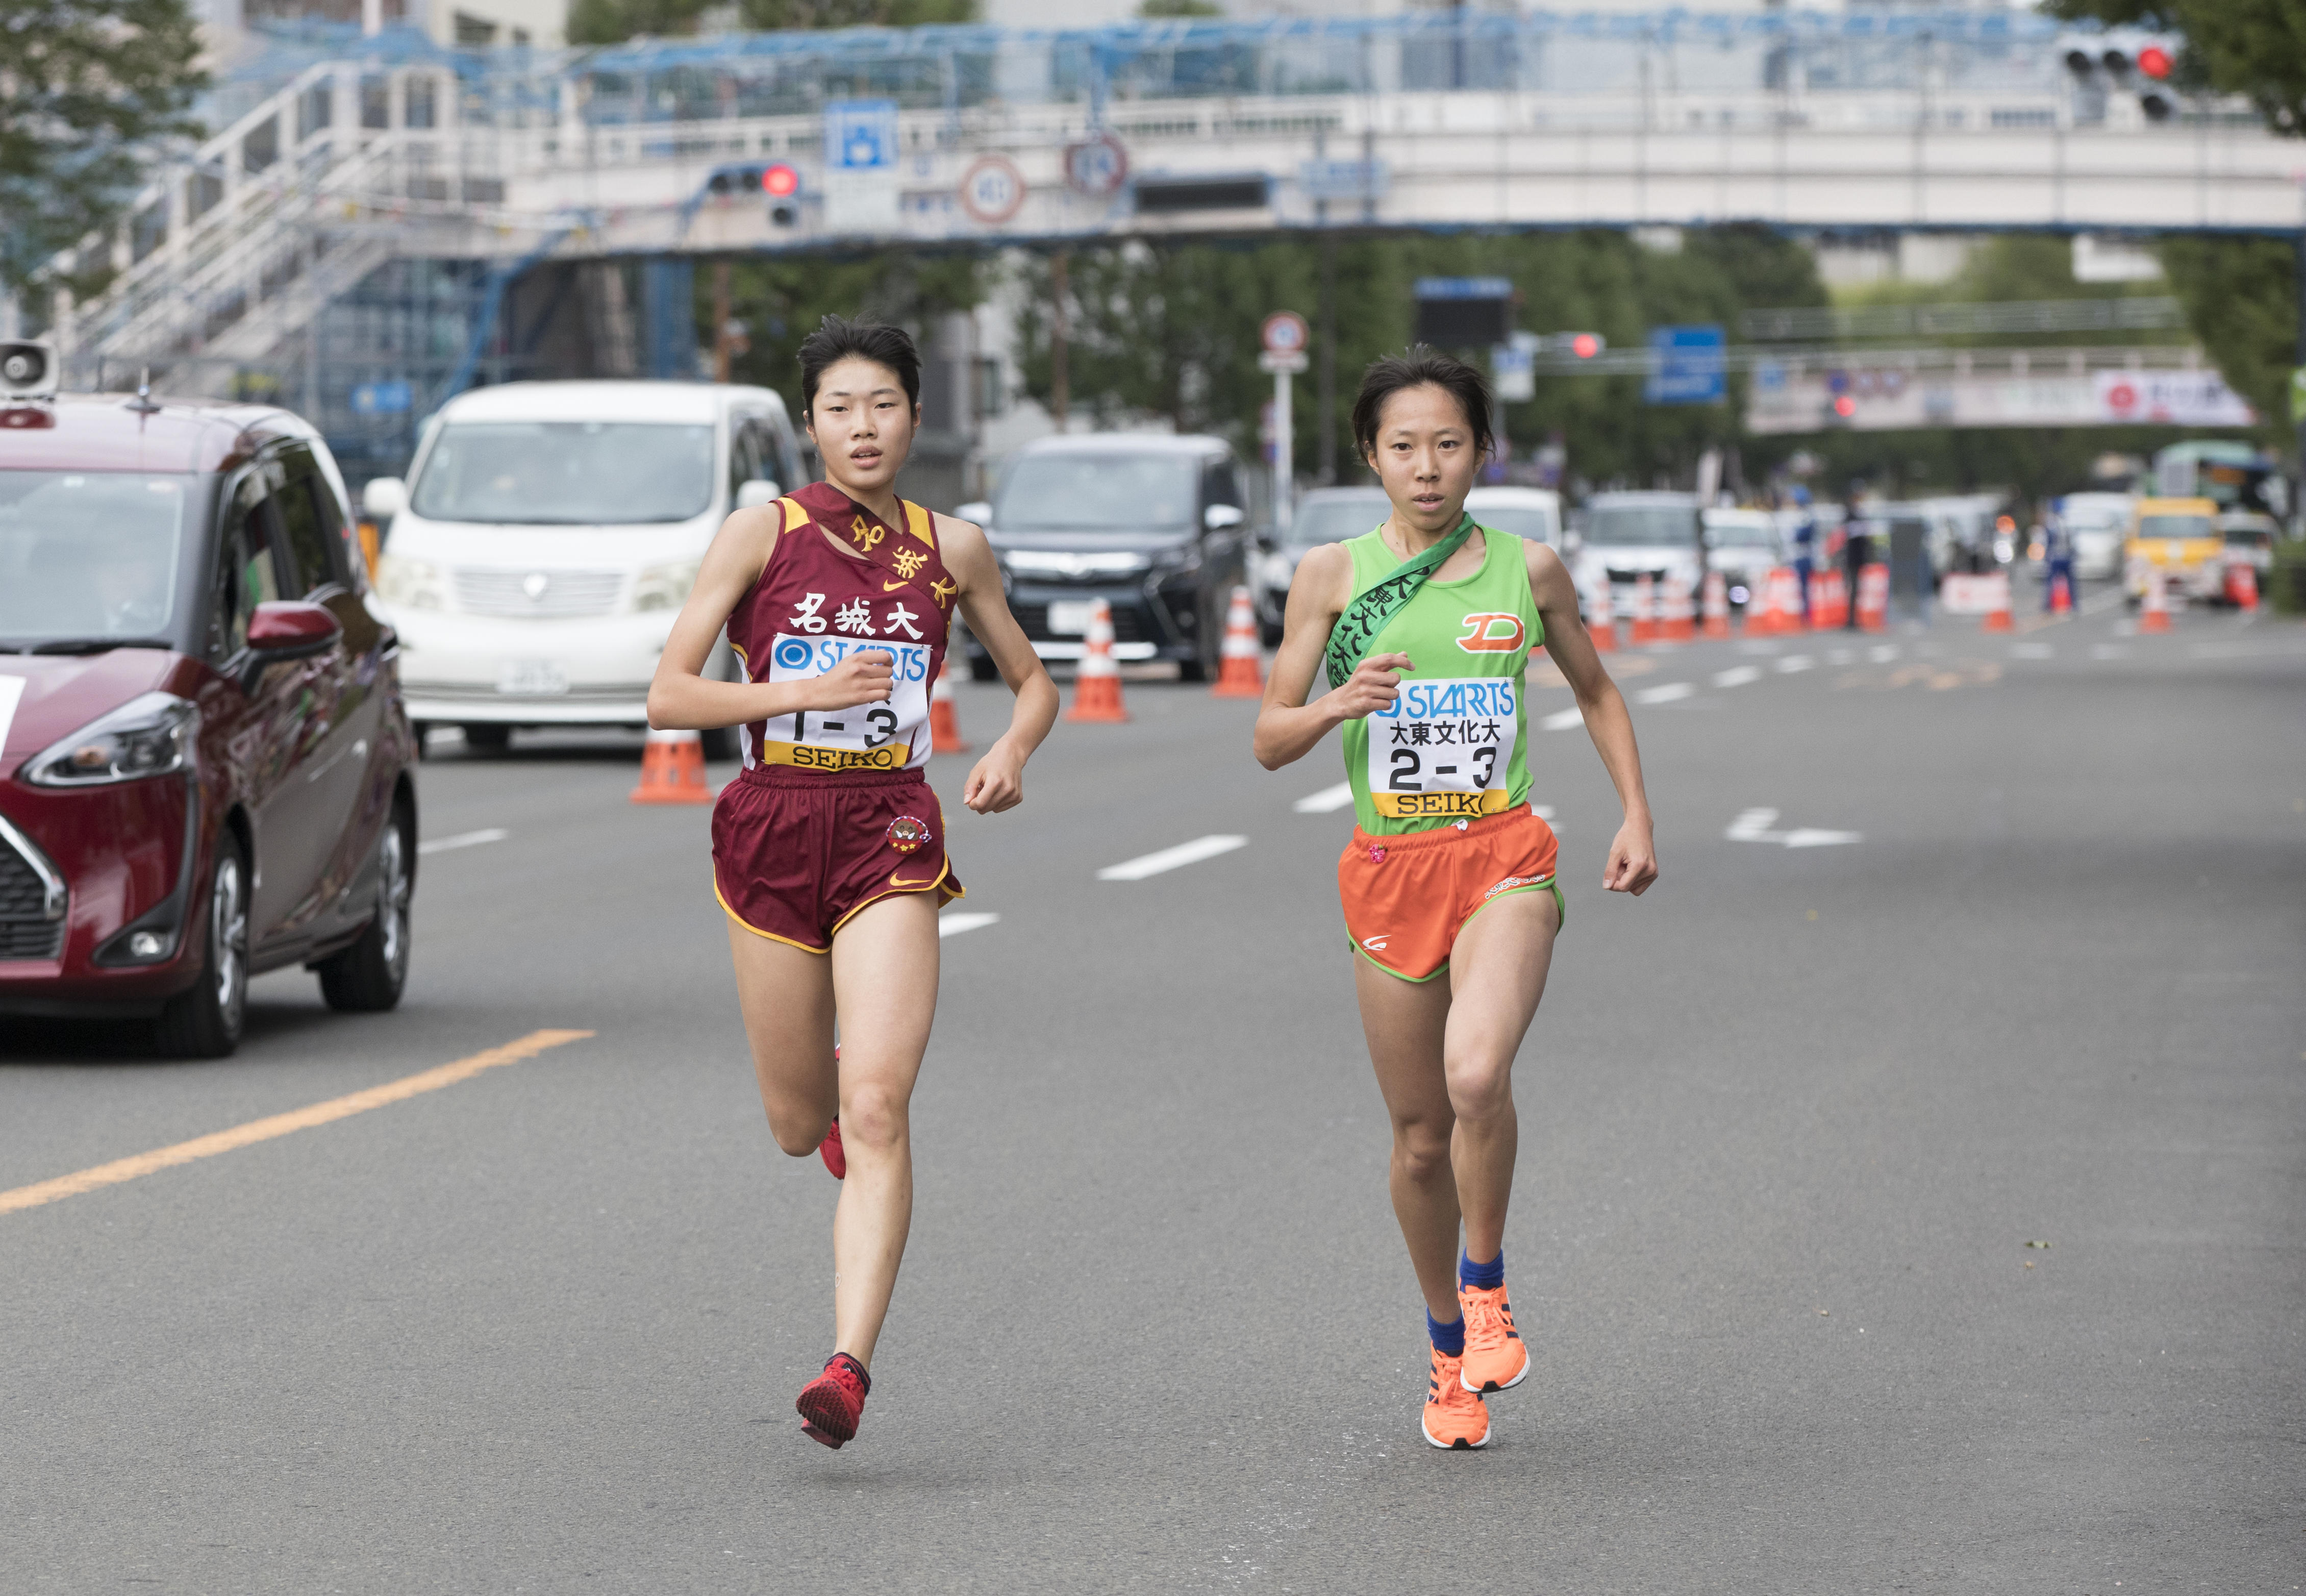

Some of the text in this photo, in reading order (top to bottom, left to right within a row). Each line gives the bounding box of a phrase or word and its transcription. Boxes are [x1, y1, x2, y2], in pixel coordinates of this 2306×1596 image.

[850, 514, 958, 639] 名城大
[789, 592, 923, 640] 名城大
[817, 641, 925, 682] STRTS
[1406, 683, 1514, 719] STARTS
[1390, 718, 1501, 746] 大東文化大
[793, 746, 893, 769] SEIKO
[1396, 792, 1486, 815] SEIK
